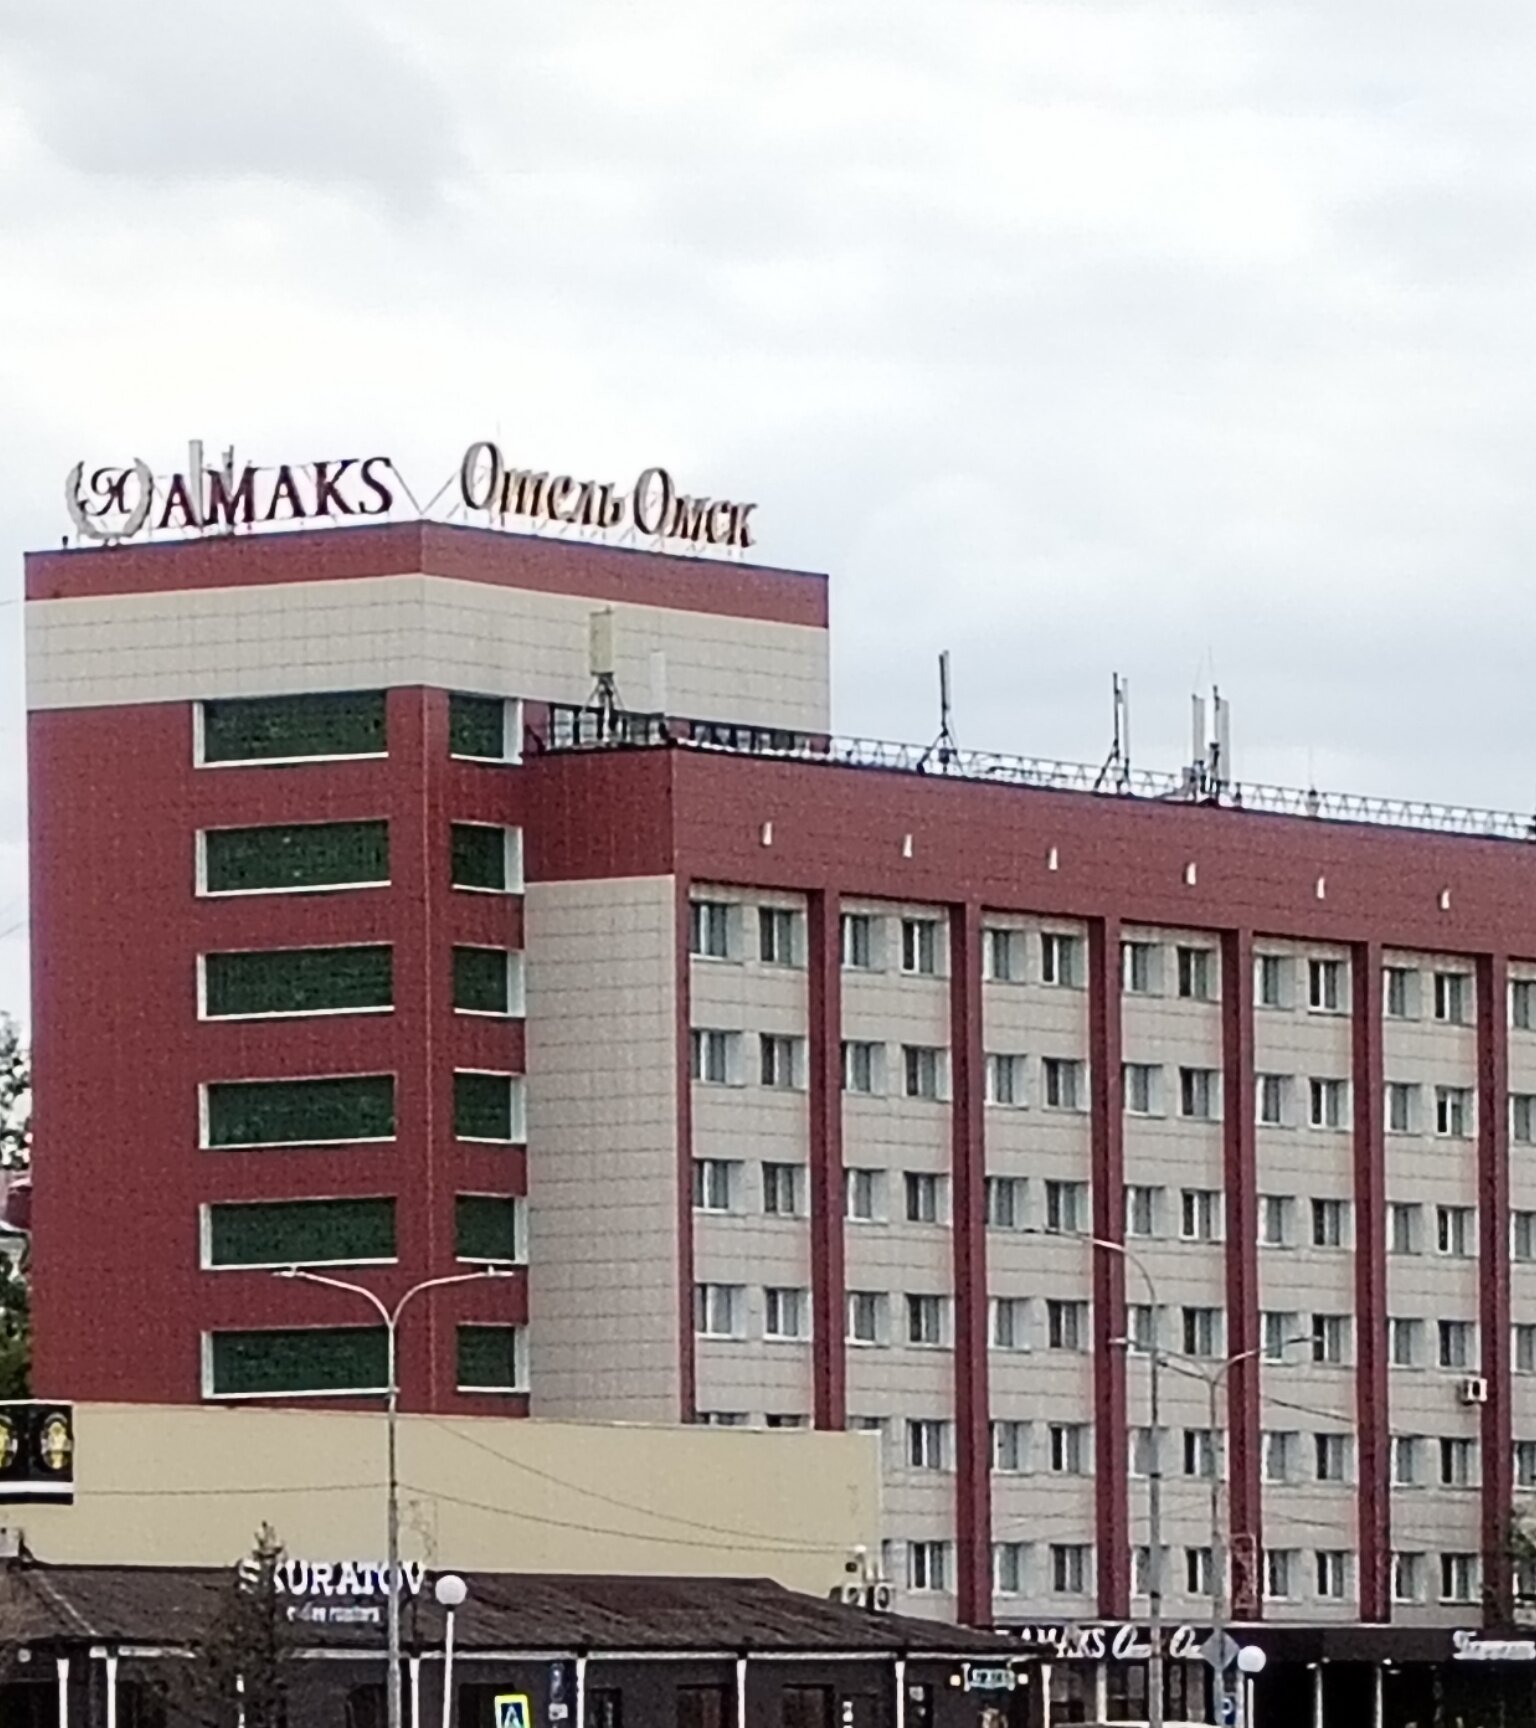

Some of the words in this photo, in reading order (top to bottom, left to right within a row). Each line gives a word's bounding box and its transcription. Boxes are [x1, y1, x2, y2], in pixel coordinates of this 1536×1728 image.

[158, 457, 394, 529] AMAKS
[460, 441, 625, 528] Отель
[633, 466, 758, 548] Омск
